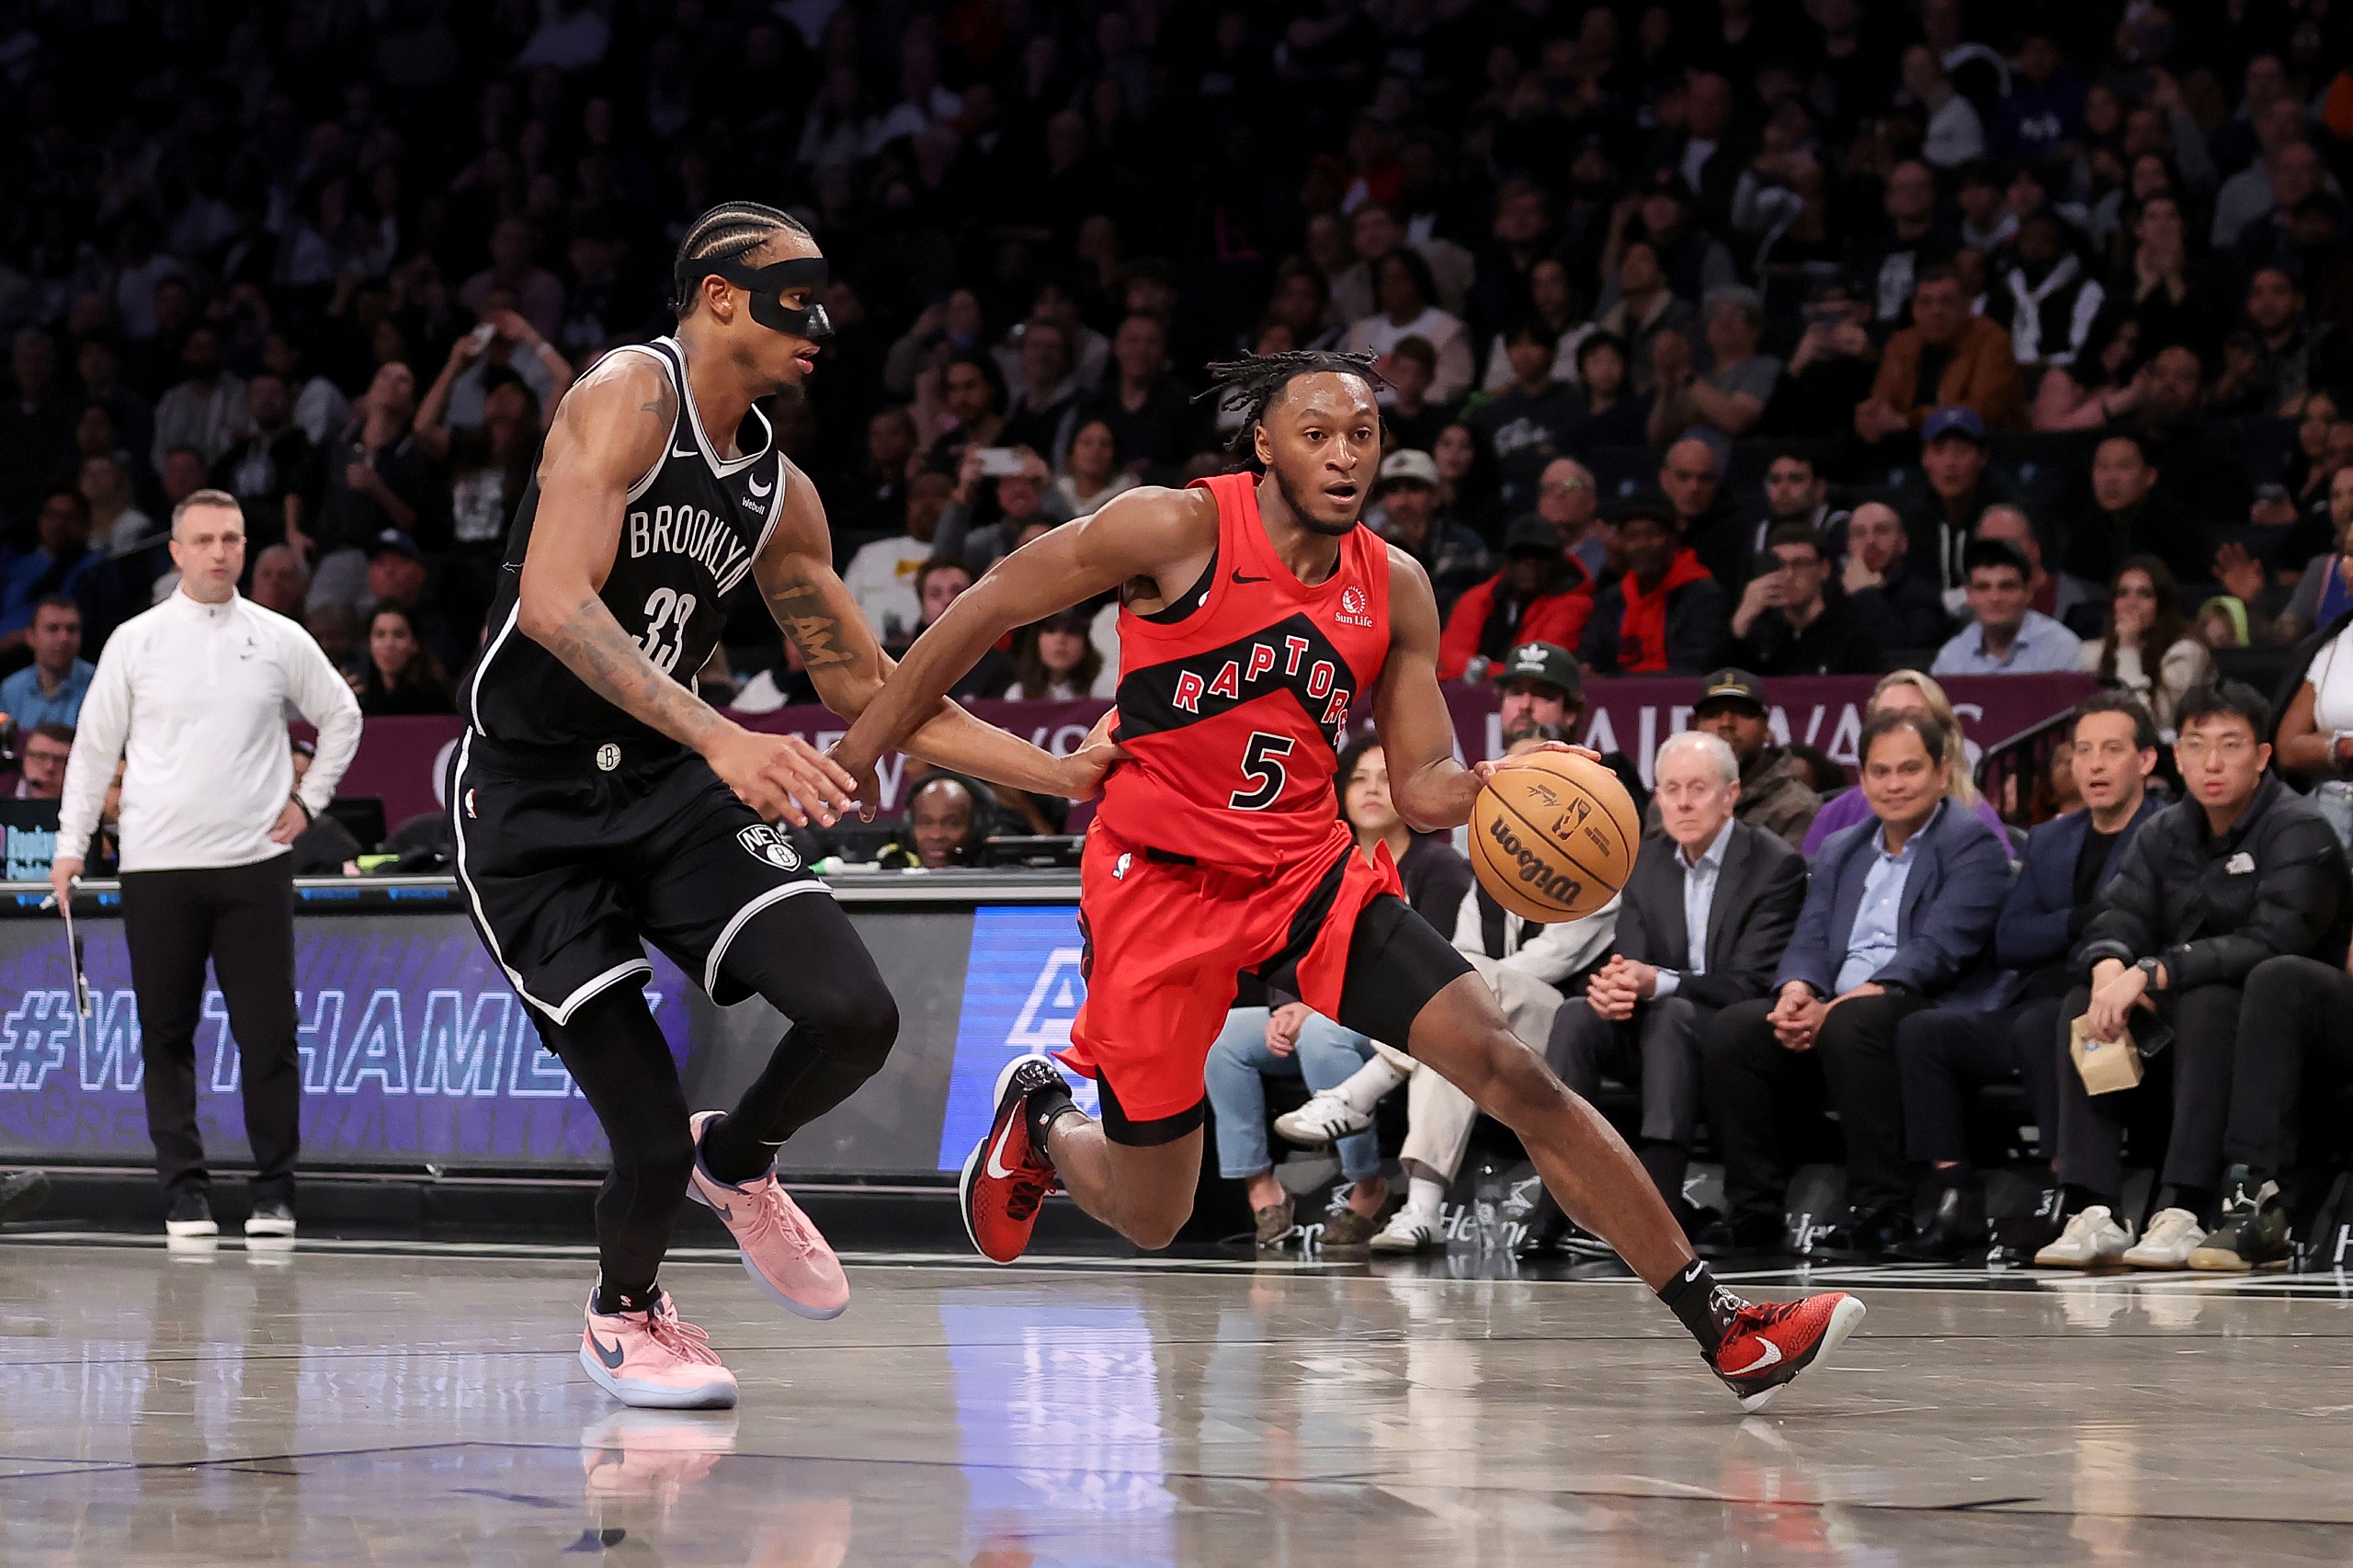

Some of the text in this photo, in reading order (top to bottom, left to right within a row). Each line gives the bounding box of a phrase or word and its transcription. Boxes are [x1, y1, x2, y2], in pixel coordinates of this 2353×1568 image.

[742, 496, 765, 516] Webull
[631, 504, 751, 598] BROOKLYN
[631, 586, 697, 676] 33
[1335, 611, 1373, 628] Sun Life
[606, 746, 614, 768] B
[1228, 731, 1296, 812] 5
[1489, 814, 1583, 907] Wilson
